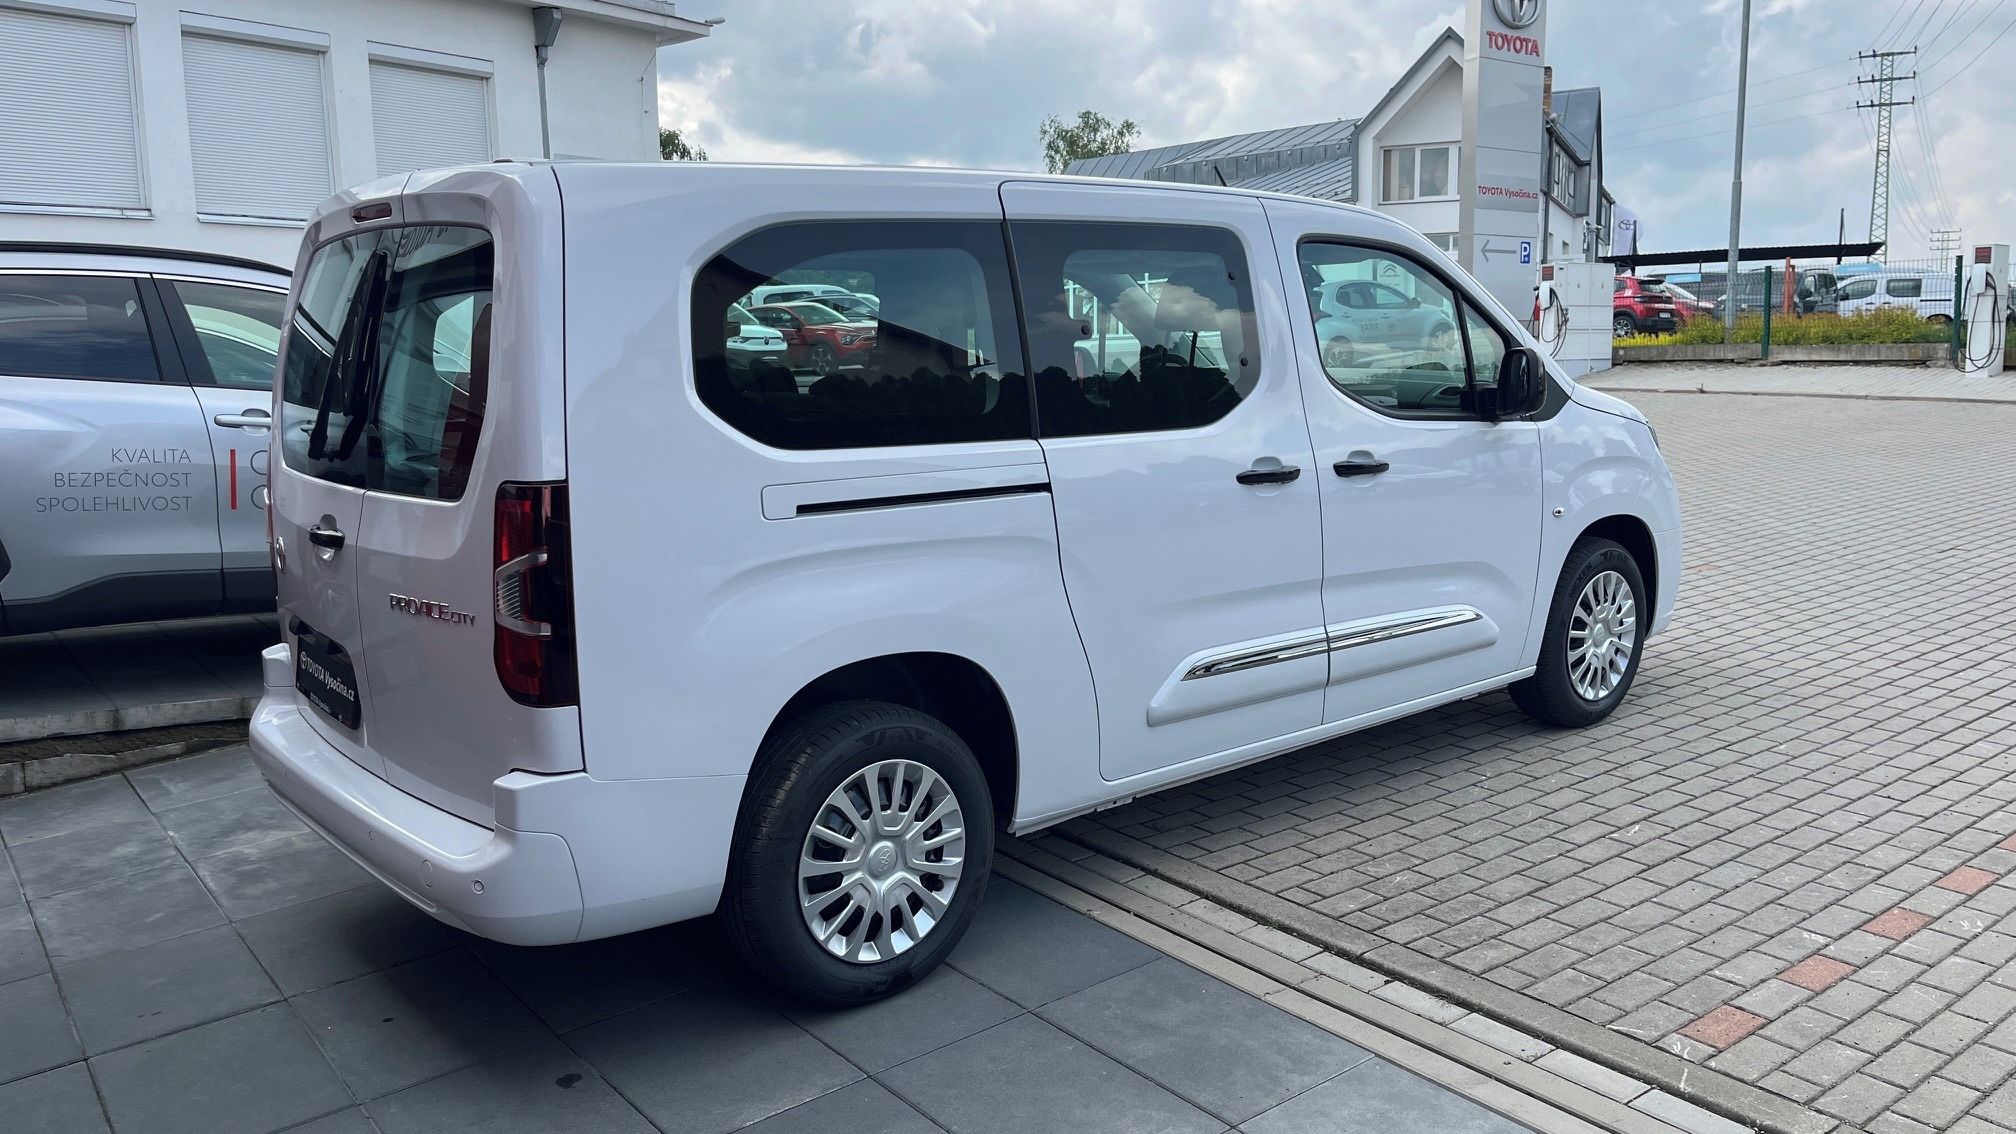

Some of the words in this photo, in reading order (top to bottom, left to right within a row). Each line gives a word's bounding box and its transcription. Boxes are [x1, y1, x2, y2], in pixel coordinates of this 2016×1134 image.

[1486, 30, 1540, 57] TOYOTA
[1478, 186, 1503, 197] TOYOTA
[1504, 188, 1538, 199] Vysočina.cz
[1521, 243, 1530, 262] P
[111, 448, 192, 464] KVALITA
[54, 469, 192, 488] BEZPEČNOST
[36, 496, 193, 513] SPOLEHLIVOST
[389, 593, 450, 621] PROACE
[450, 610, 476, 626] CITY
[307, 657, 325, 683] TOYOTA
[325, 670, 355, 702] Vysočina.cz
